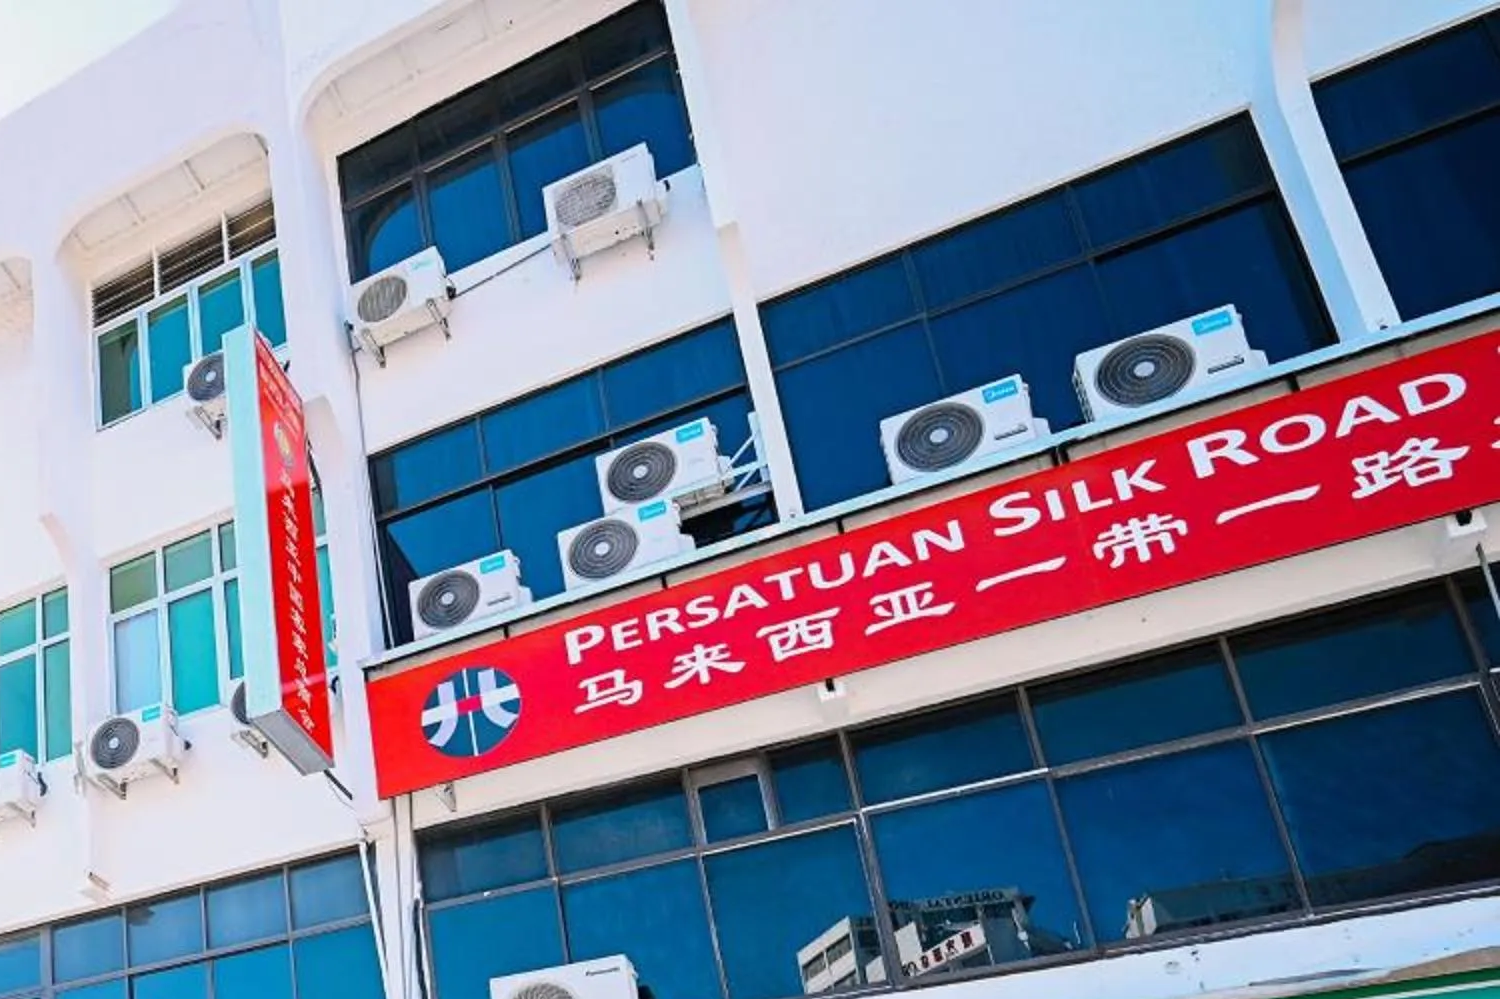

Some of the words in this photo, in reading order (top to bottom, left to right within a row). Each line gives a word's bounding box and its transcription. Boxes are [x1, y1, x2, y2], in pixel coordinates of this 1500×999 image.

[564, 519, 966, 666] PERSATUAN
[991, 458, 1166, 535] SILK
[1187, 372, 1467, 478] ROAD
[573, 436, 1500, 715] 马来西亚一带一路
